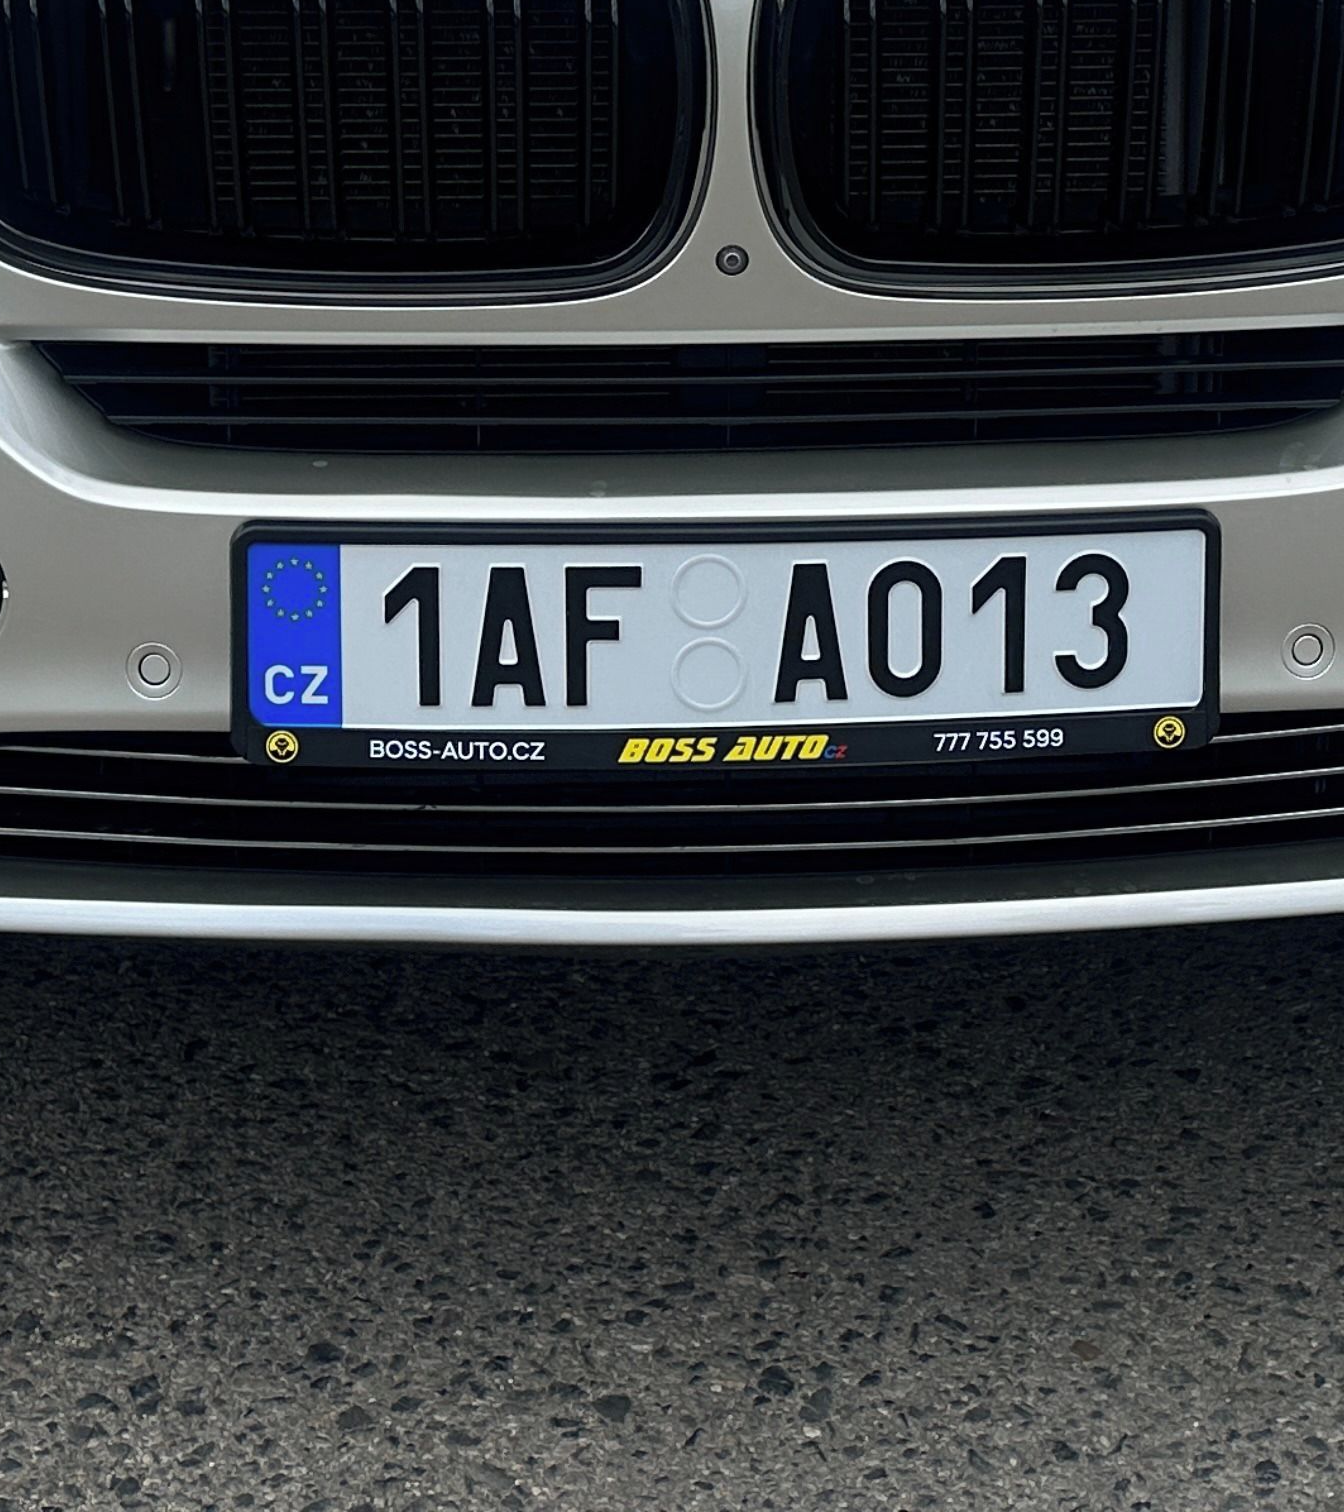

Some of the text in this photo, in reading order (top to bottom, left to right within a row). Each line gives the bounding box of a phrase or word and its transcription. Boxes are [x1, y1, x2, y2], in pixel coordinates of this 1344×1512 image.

[384, 553, 1130, 707] 1AF A013
[264, 664, 329, 705] CZ
[369, 739, 545, 761] BOSS-AUTO.CZ
[618, 737, 718, 763] BOSS
[722, 734, 830, 762] AUTO
[933, 727, 1064, 752] 777 755 599
